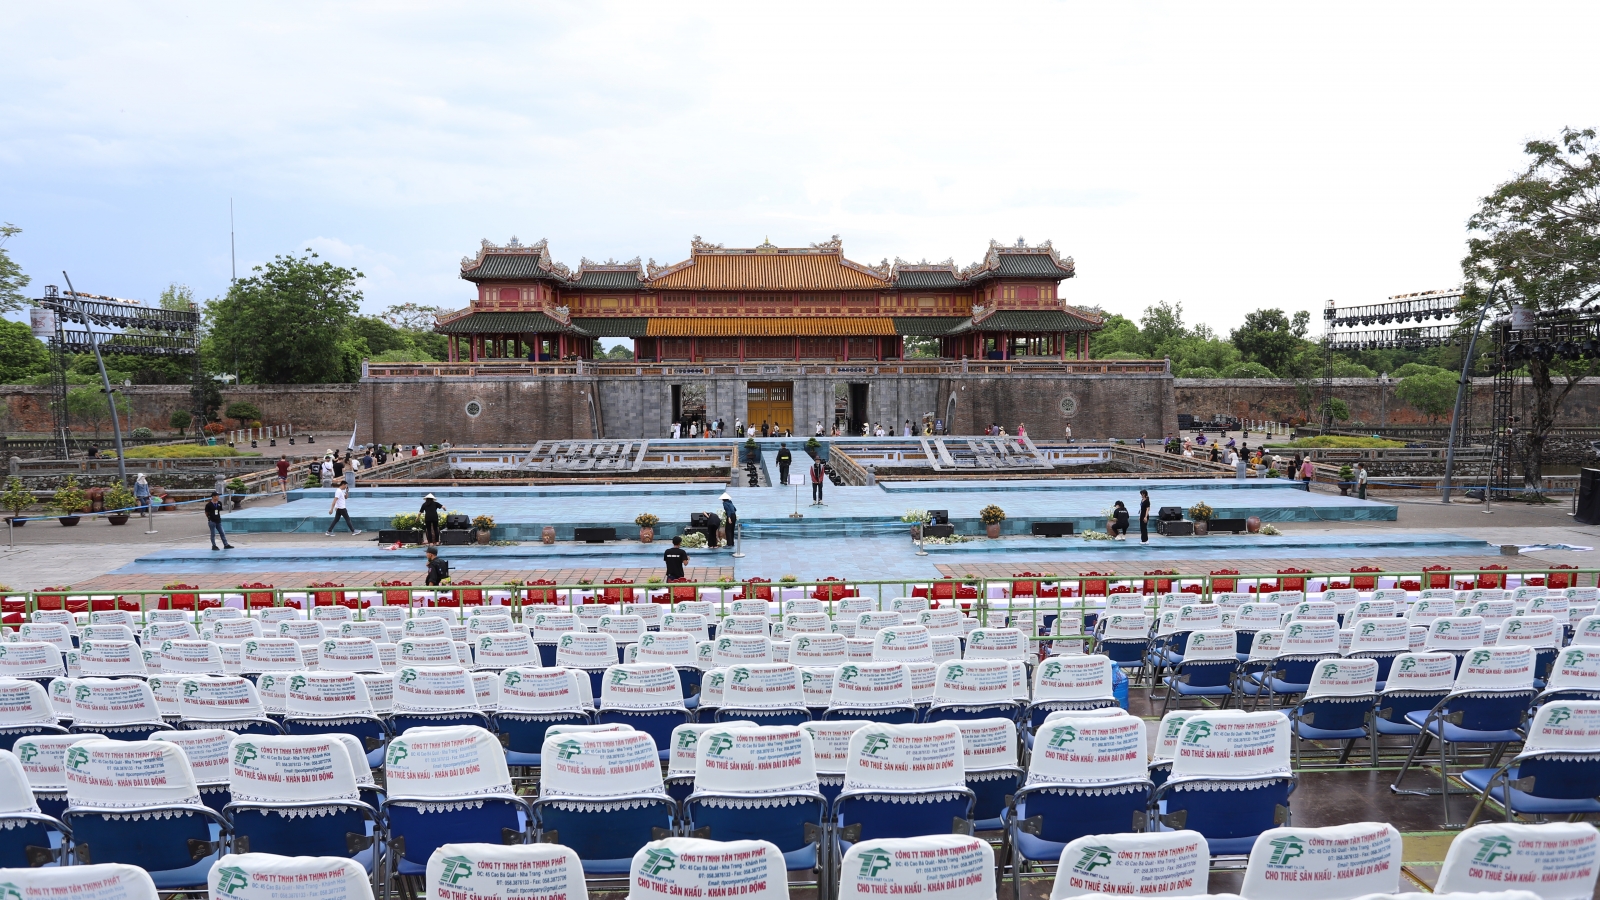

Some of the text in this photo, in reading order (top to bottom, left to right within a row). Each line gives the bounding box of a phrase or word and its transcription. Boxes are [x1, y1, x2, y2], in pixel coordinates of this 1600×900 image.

[1192, 749, 1204, 757] THUÊ
[1206, 749, 1216, 758] SÂN
[1217, 748, 1230, 758] KHẤU
[706, 759, 715, 767] CHO
[717, 761, 728, 770] THUÊ
[730, 761, 739, 770] SÂN
[741, 761, 754, 770] KHẤU
[759, 761, 771, 770] KHÁN
[235, 768, 243, 776] CHO
[244, 770, 256, 779] THUÊ
[257, 772, 266, 780] SÂN
[268, 772, 281, 782] KHẤU
[286, 774, 300, 783] KHÁN
[302, 773, 311, 782] ĐÀI
[319, 772, 334, 781] ĐỘNG
[1309, 838, 1324, 846] CÔNG
[1350, 837, 1360, 845] TÂN
[1518, 839, 1533, 848] CÔNG
[1535, 840, 1541, 848] TY
[1543, 840, 1557, 848] TNHH
[681, 853, 695, 862] CÔNG
[734, 852, 750, 861] THỊNH
[752, 848, 766, 858] PHÁT
[895, 850, 910, 858] CÔNG
[920, 850, 935, 858] TNHH
[937, 848, 948, 856] TÂN
[950, 846, 966, 856] THỊNH
[1118, 851, 1132, 859] CÔNG
[1158, 849, 1168, 858] TÂN
[1170, 847, 1184, 856] THỊNH
[1185, 843, 1198, 852] PHÁT
[478, 856, 566, 870] CÔNG TY TNHH TÂN THỊNH PHÁT
[731, 862, 742, 870] Trang
[253, 873, 268, 881] CÔNG
[295, 874, 307, 882] TÂN
[309, 873, 327, 882] THỊNH
[329, 868, 344, 878] PHÁT
[1265, 870, 1278, 880] CHO
[1281, 870, 1297, 881] THUÊ
[1300, 870, 1312, 881] SÂN
[1314, 868, 1331, 880] KHẤU
[1337, 868, 1354, 879] KHÁN
[1356, 864, 1365, 876] ĐÀI
[1366, 865, 1373, 874] DI
[1469, 868, 1483, 878] CHO
[1485, 870, 1502, 881] THUÊ
[1504, 871, 1517, 882] SÂN
[1518, 870, 1537, 882] KHẤU
[26, 887, 41, 895] CÔNG
[51, 887, 68, 895] TNHH
[70, 884, 82, 892] TÂN
[83, 880, 102, 891] THỊNH
[103, 876, 120, 886] PHÁT
[638, 878, 766, 897] CHO THUÊ SÂN KHẤU KHÁN ĐÀI DI ĐỘNG
[857, 873, 982, 894] CHO THUÊ SÂN KHẤU KHÁN ĐÀI DI ĐỘNG
[1070, 877, 1192, 894] CHO THUÊ SÂN KHẤU KHÁN ĐÀI DI ĐỘNG
